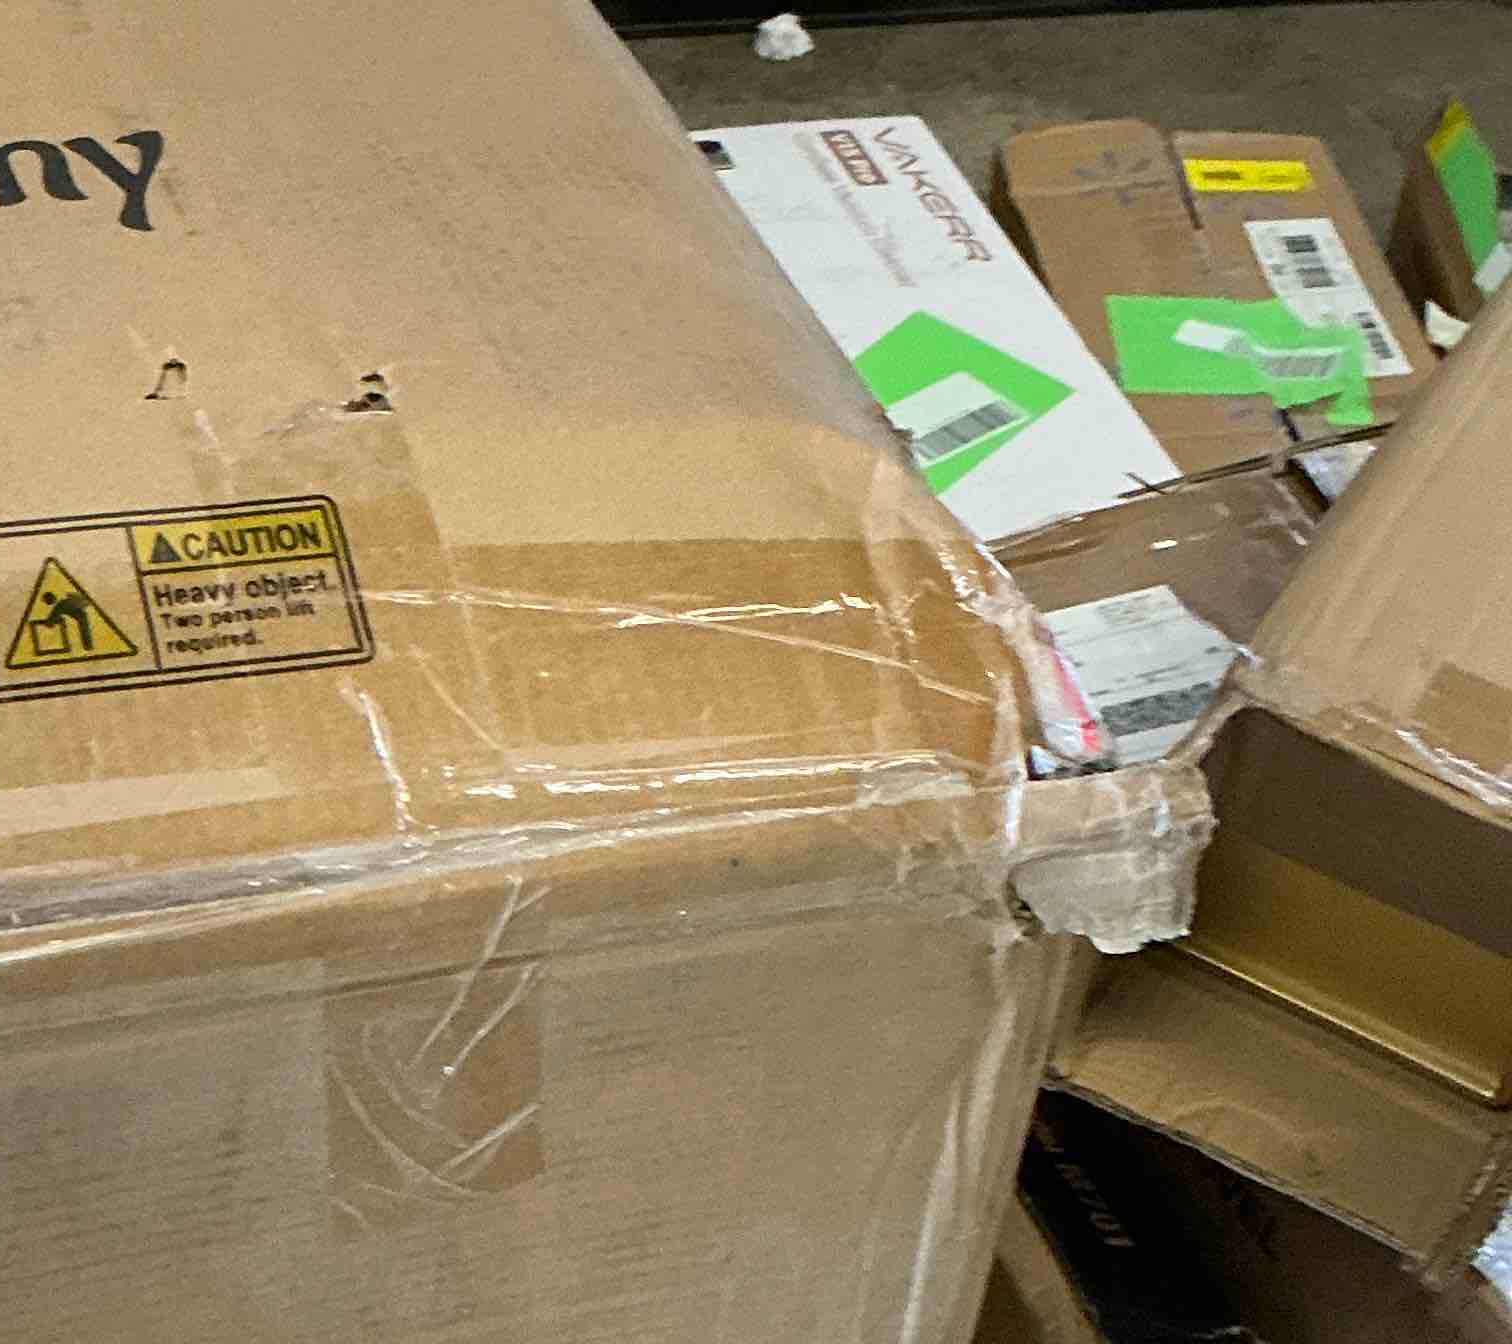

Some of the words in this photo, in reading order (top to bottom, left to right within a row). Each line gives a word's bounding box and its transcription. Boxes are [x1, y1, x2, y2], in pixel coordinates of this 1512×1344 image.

[181, 522, 322, 560] CAUTION
[153, 581, 235, 607] Heavy
[245, 569, 328, 601] object
[160, 613, 203, 629] Two
[210, 607, 282, 628] person
